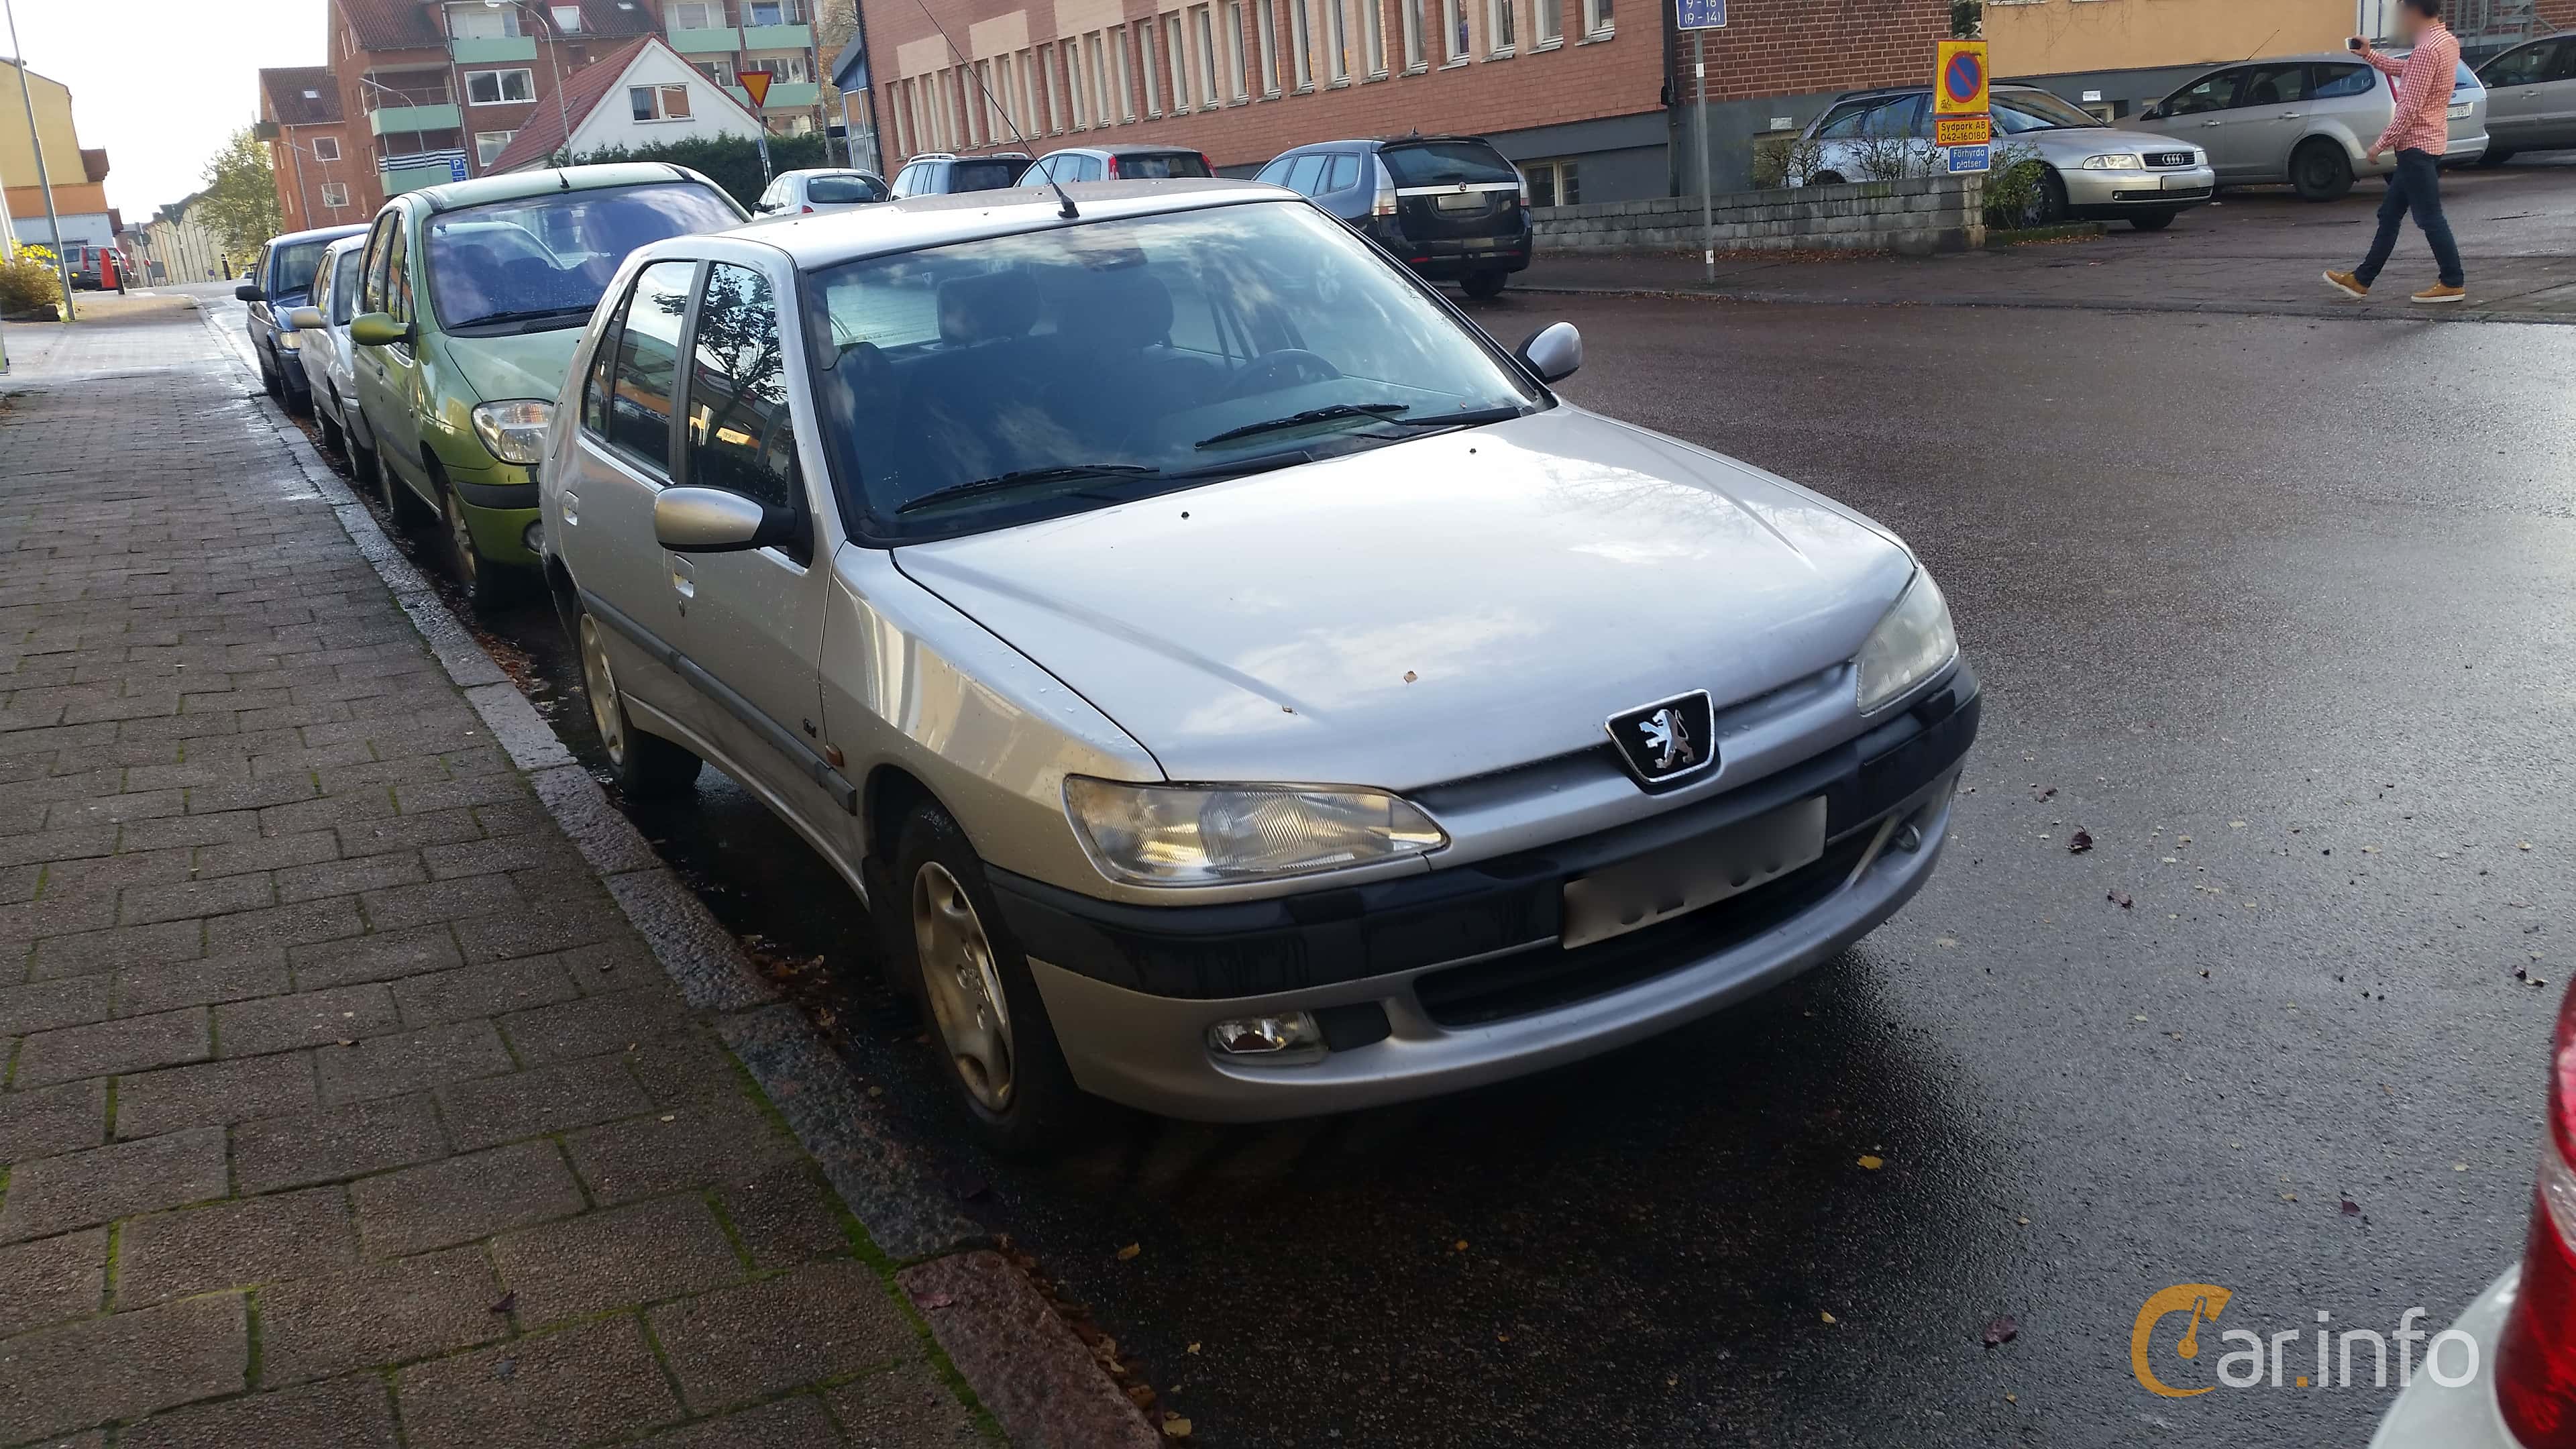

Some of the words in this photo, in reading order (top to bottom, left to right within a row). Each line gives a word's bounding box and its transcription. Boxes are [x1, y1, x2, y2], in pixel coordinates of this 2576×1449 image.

[1707, 11, 1721, 23] 14)
[1941, 121, 1973, 132] Sydpark
[1976, 121, 1986, 129] AB
[1941, 131, 1986, 141] 042-160180
[1953, 148, 1985, 159] Förhyrda
[453, 159, 461, 169] P
[1956, 160, 1982, 170] platser
